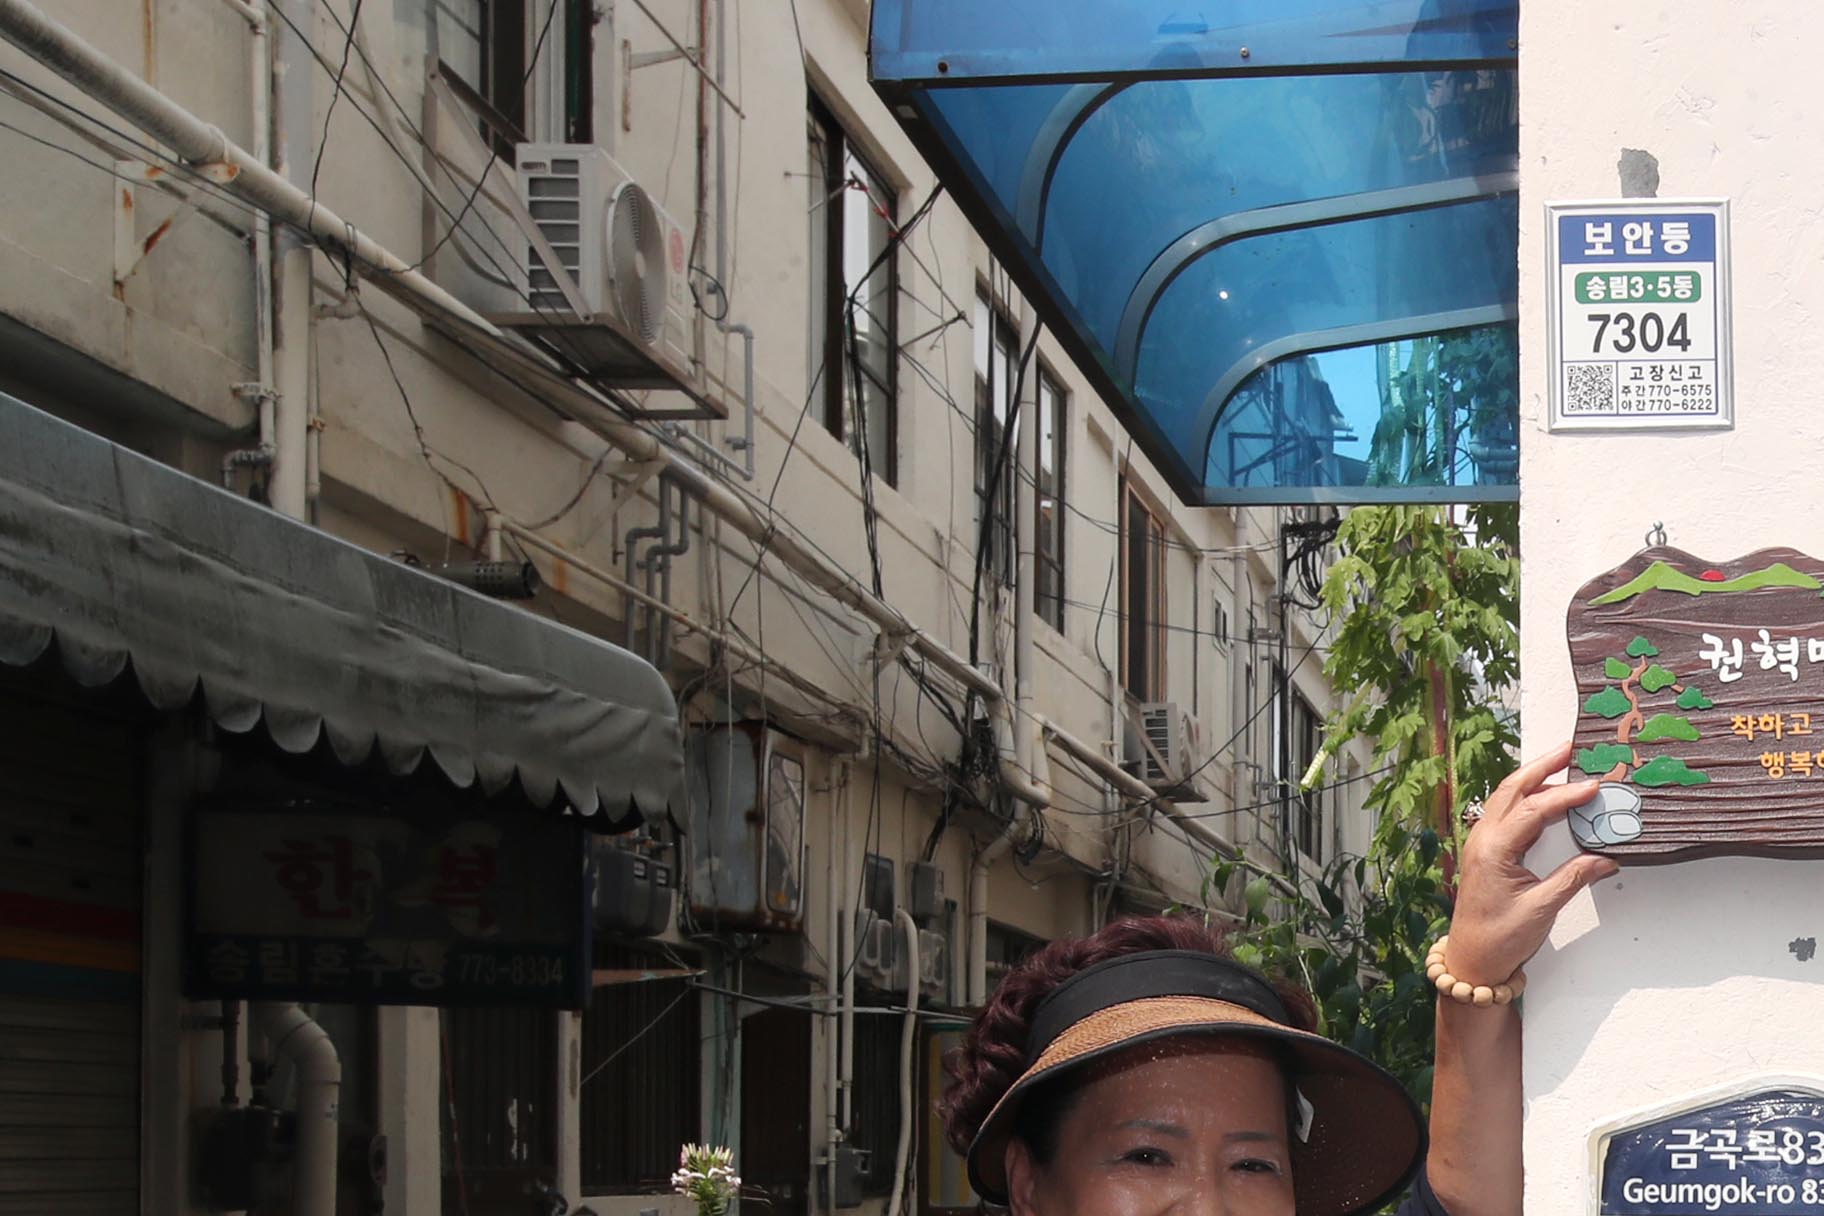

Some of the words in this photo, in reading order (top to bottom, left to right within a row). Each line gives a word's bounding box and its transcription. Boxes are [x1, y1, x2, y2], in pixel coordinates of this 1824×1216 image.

[1583, 222, 1692, 255] 보안등
[1585, 275, 1694, 300] 송림3·5동
[1587, 312, 1692, 353] 7304
[1629, 364, 1703, 382] 고장신고
[1730, 712, 1813, 742] 착하고
[1622, 1178, 1797, 1211] Geumgok-ro
